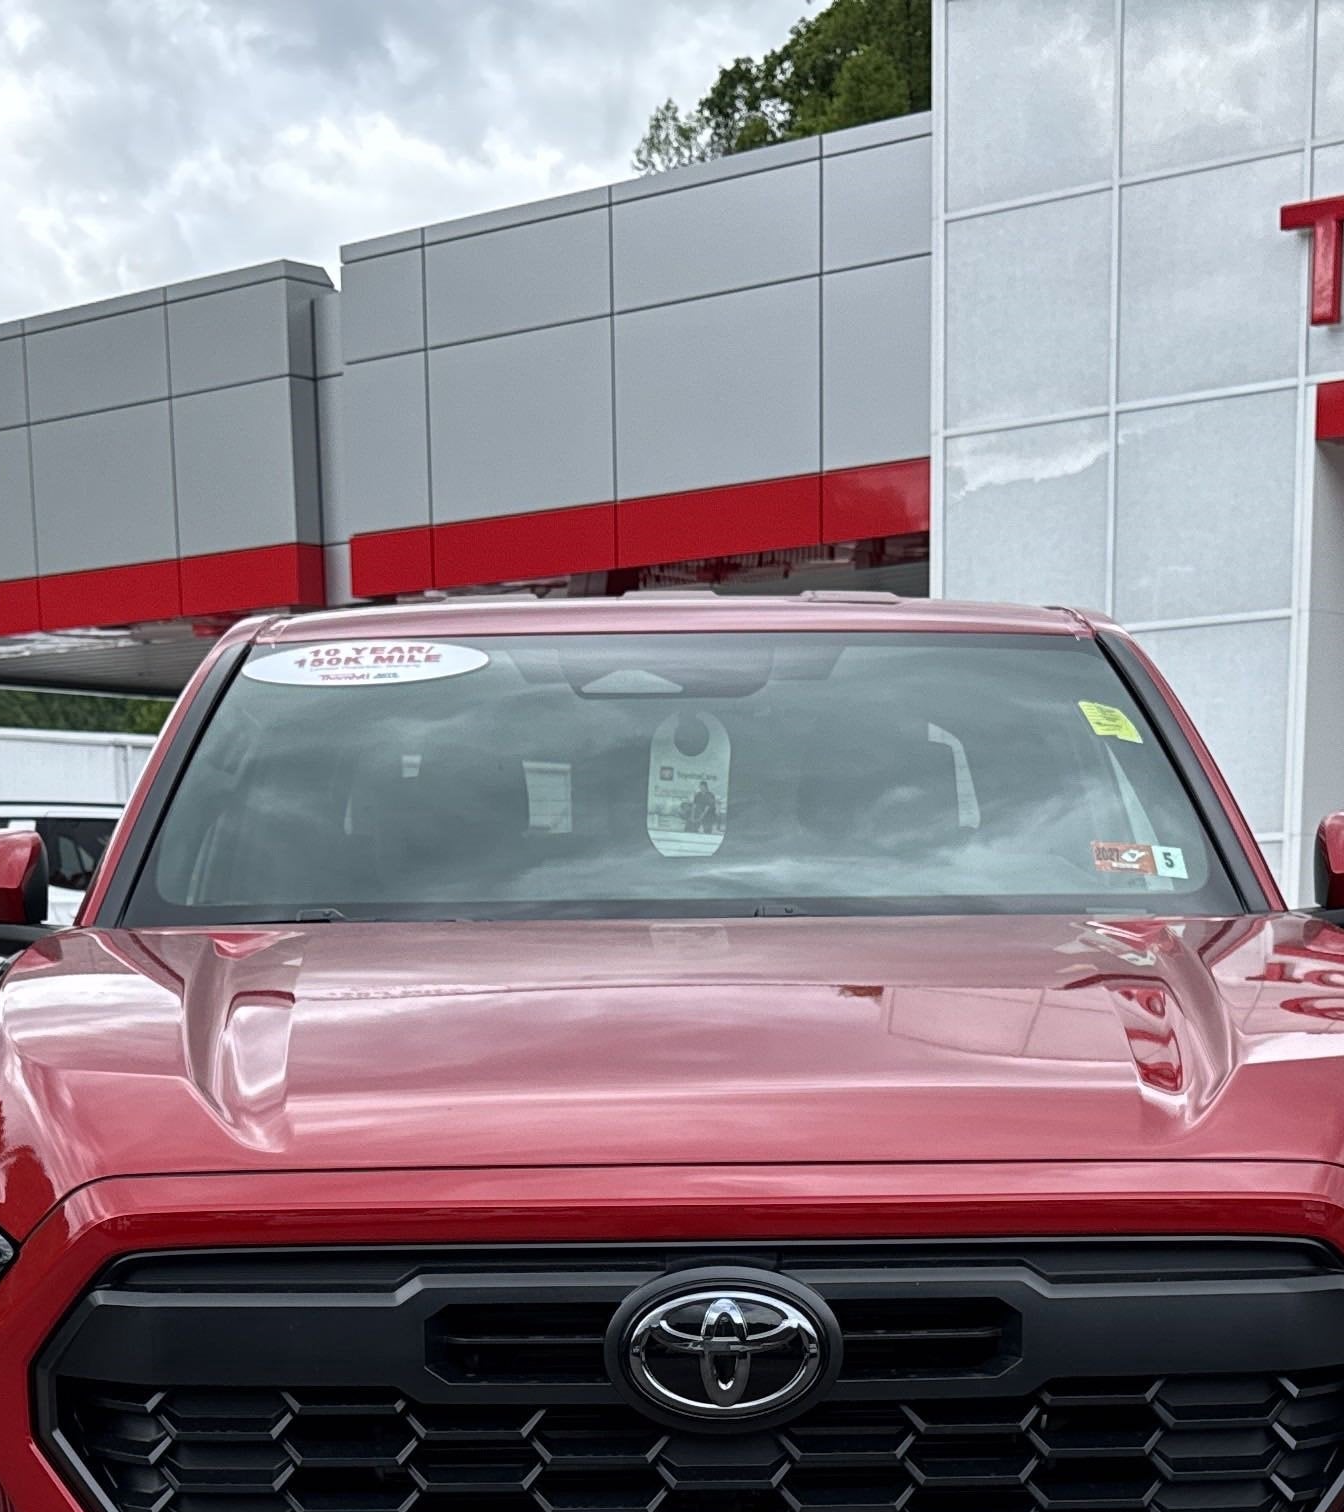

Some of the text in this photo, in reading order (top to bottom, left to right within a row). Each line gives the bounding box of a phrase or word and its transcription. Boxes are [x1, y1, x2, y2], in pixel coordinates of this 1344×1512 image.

[310, 646, 434, 658] 10 YEAR/
[294, 656, 365, 668] 150K
[373, 654, 441, 664] MILE
[1162, 852, 1175, 868] 5
